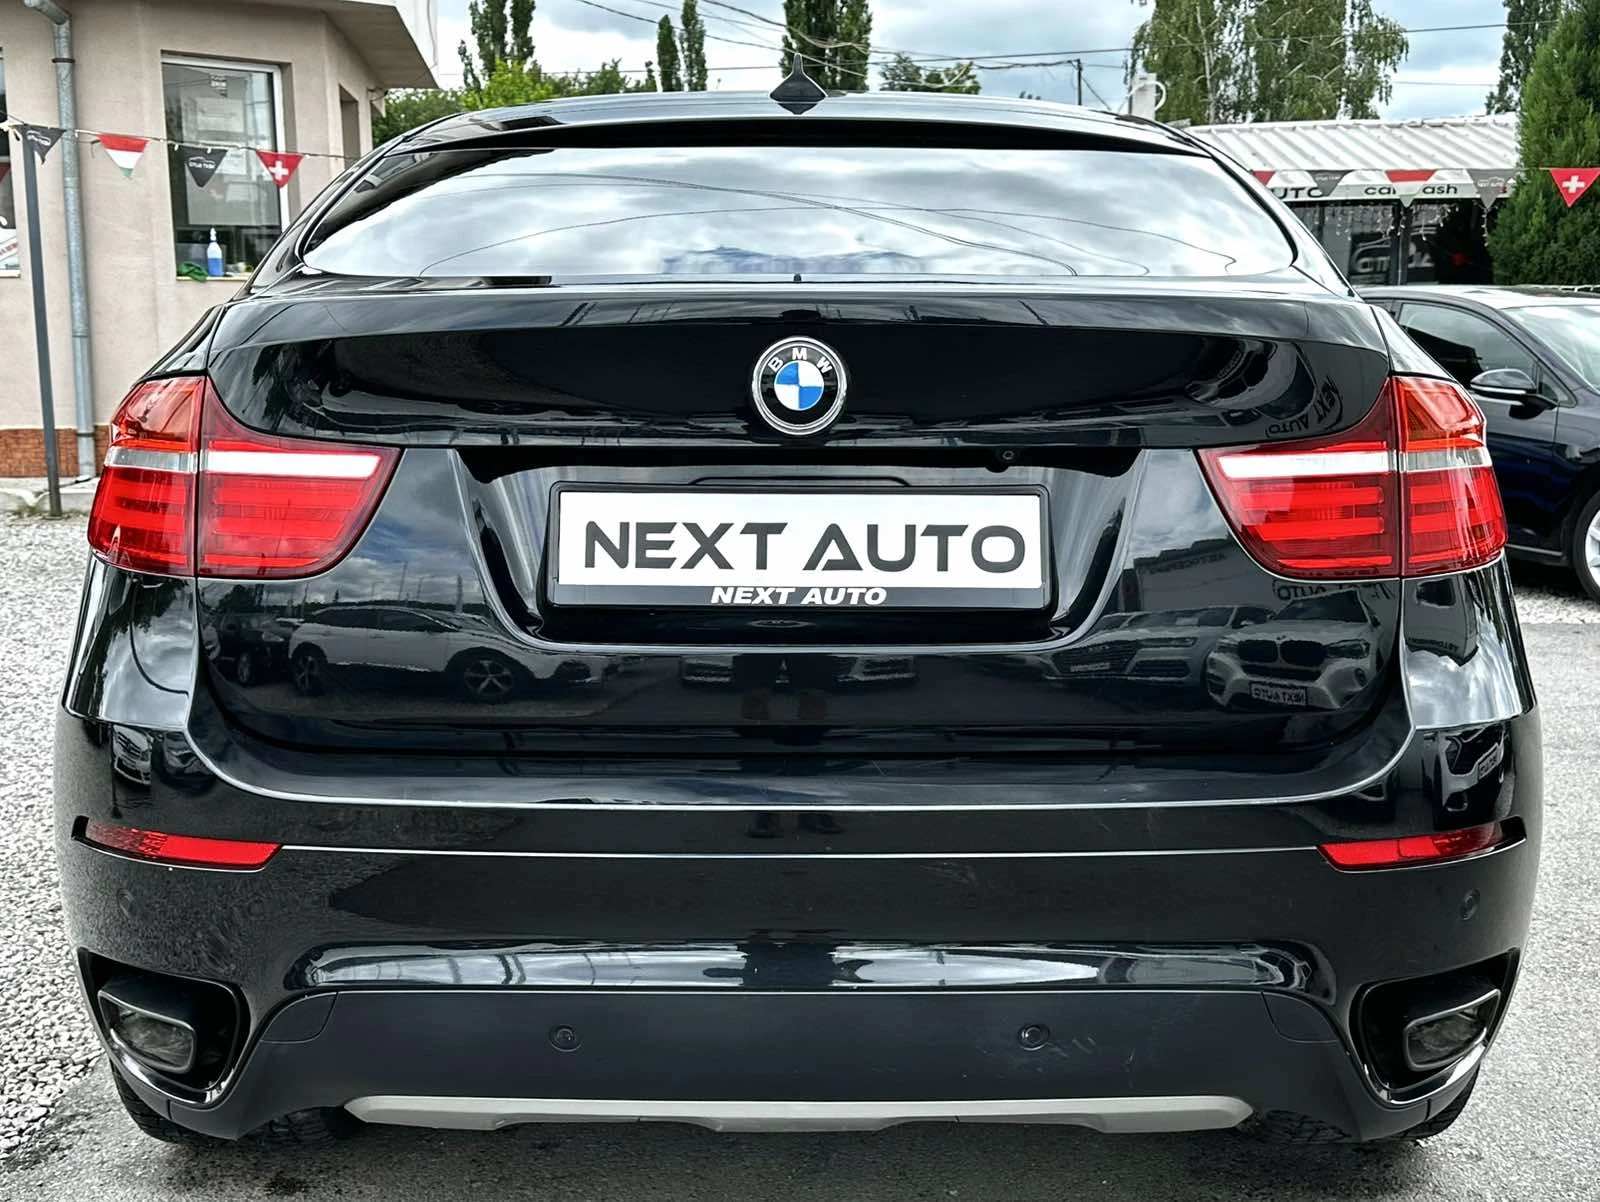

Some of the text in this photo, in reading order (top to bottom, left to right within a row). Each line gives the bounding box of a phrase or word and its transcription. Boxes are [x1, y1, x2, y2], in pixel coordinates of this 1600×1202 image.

[1270, 187, 1324, 199] UTO
[1421, 184, 1458, 195] ash
[767, 347, 833, 374] BMW
[585, 520, 1026, 574] NEXT AUTO
[711, 586, 887, 606] NEXT AUTO
